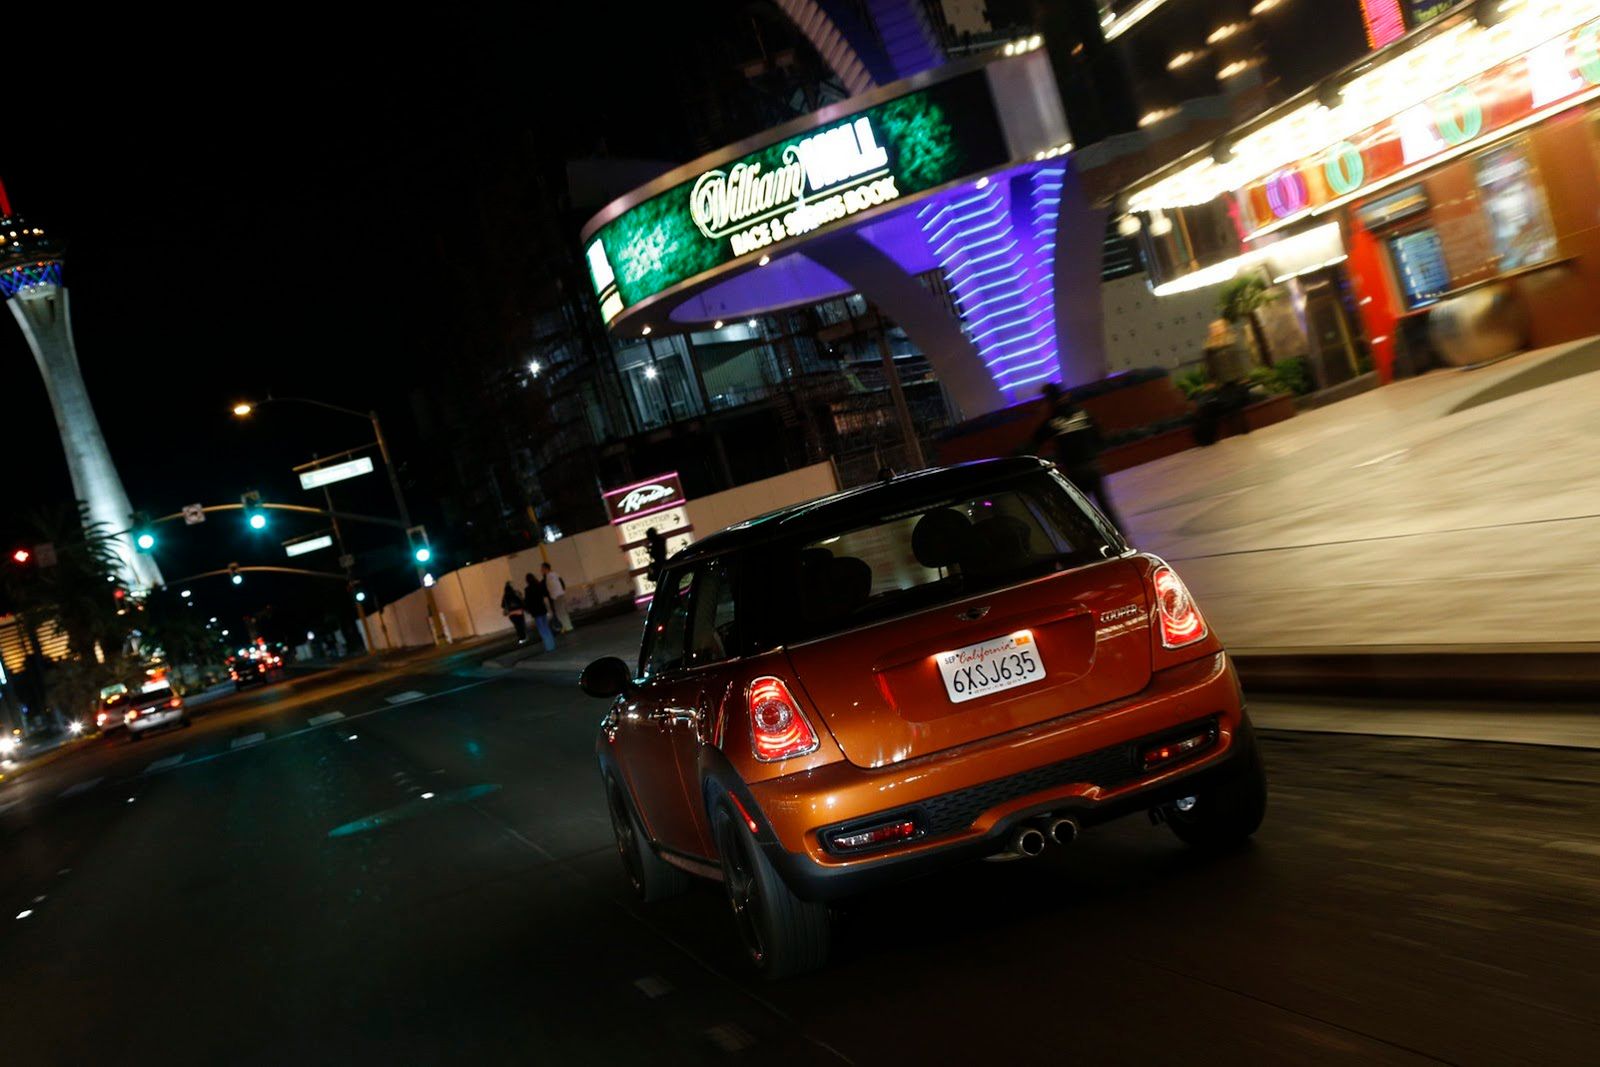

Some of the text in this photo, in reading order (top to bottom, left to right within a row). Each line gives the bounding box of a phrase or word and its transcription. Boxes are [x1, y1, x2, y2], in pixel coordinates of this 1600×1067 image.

[691, 145, 805, 237] William
[730, 222, 773, 257] RACE
[770, 218, 786, 242] &
[843, 175, 900, 214] BOOK
[1100, 603, 1137, 623] COOPER
[944, 655, 956, 665] SEP
[959, 641, 1016, 663] California
[953, 650, 1036, 693] 6XSJ635
